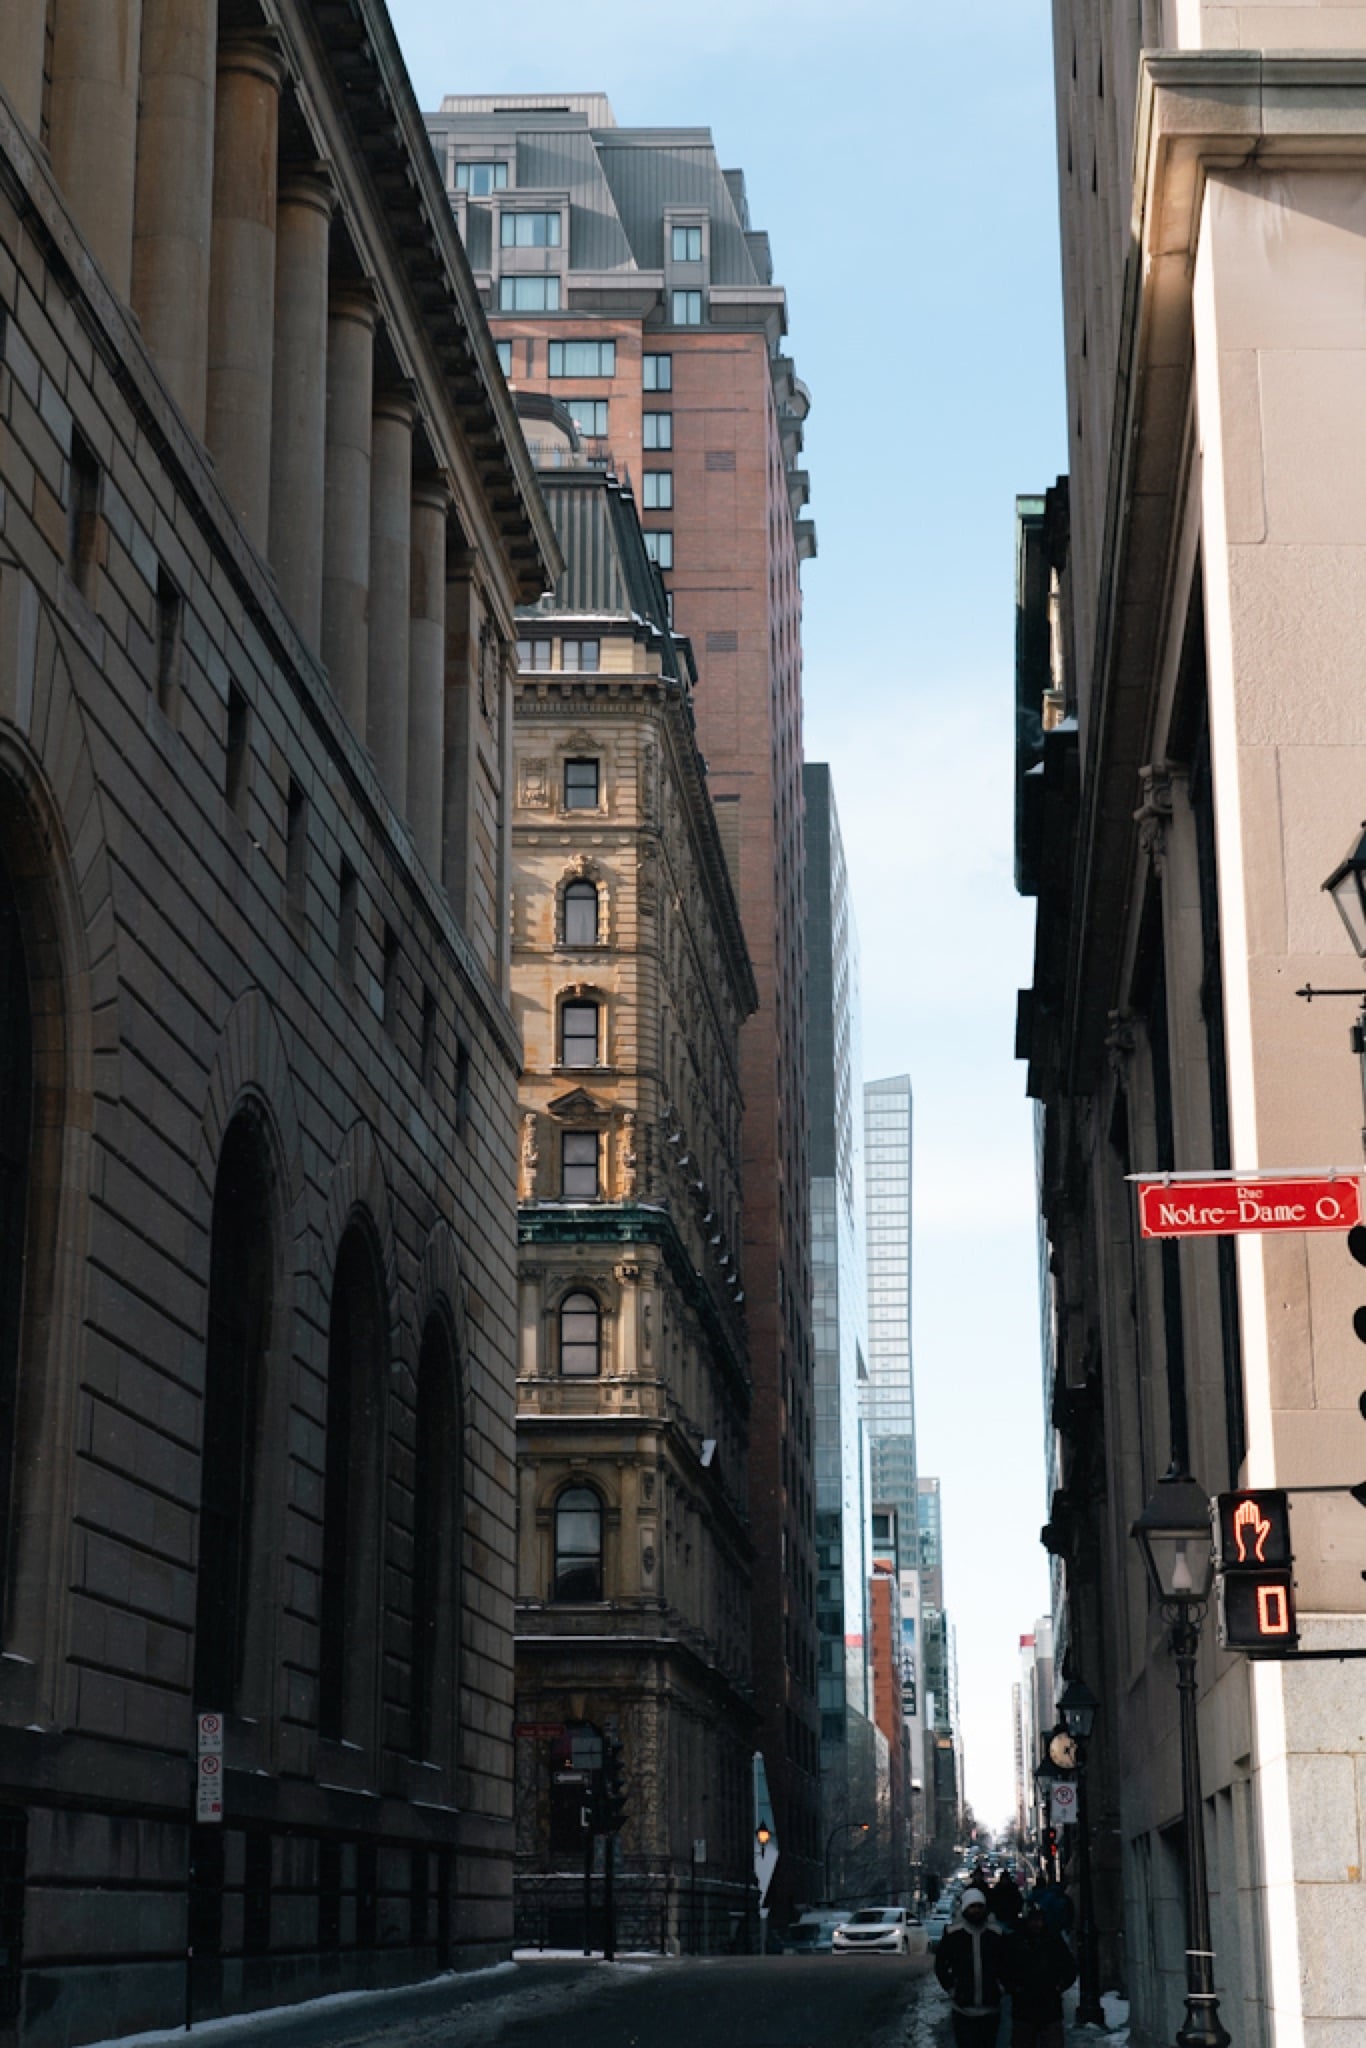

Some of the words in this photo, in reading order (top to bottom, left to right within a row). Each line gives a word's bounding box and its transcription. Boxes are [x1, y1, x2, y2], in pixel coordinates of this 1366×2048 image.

[1237, 1187, 1264, 1199] Rue
[1159, 1201, 1306, 1226] Notre-Dame
[1315, 1197, 1345, 1221] O.
[1257, 1585, 1289, 1634] 0
